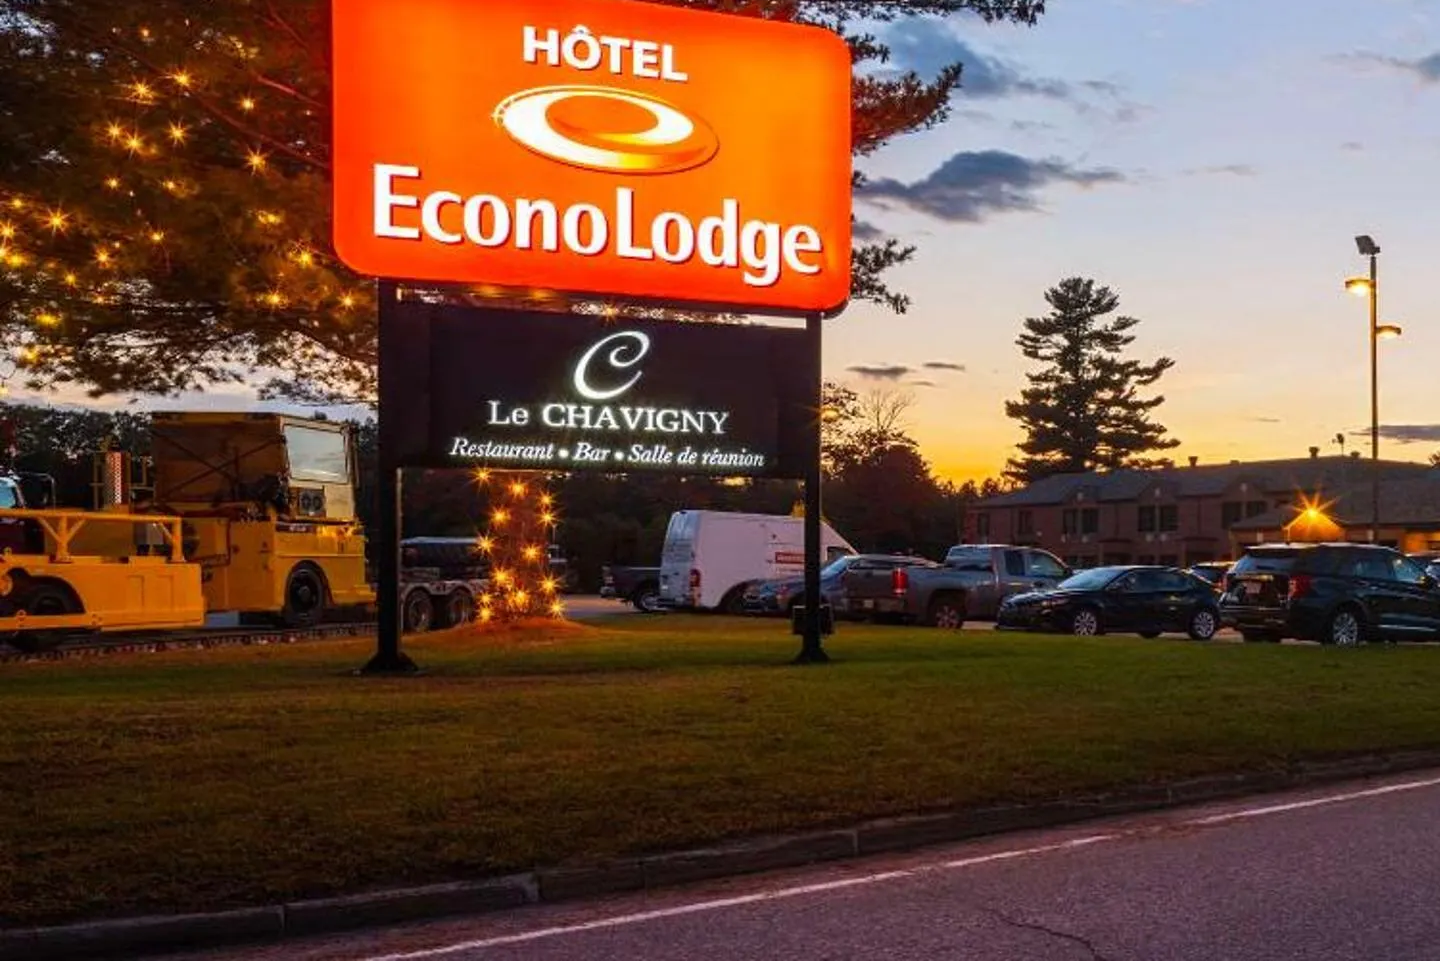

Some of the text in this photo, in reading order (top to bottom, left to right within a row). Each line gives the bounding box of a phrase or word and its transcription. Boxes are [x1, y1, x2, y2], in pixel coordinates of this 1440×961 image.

[522, 25, 688, 82] HÔTEL
[372, 162, 822, 287] EconoLodge
[487, 400, 730, 435] Le CHAVIGNY
[449, 437, 765, 468] Restaurant Bar Salle de réunion
